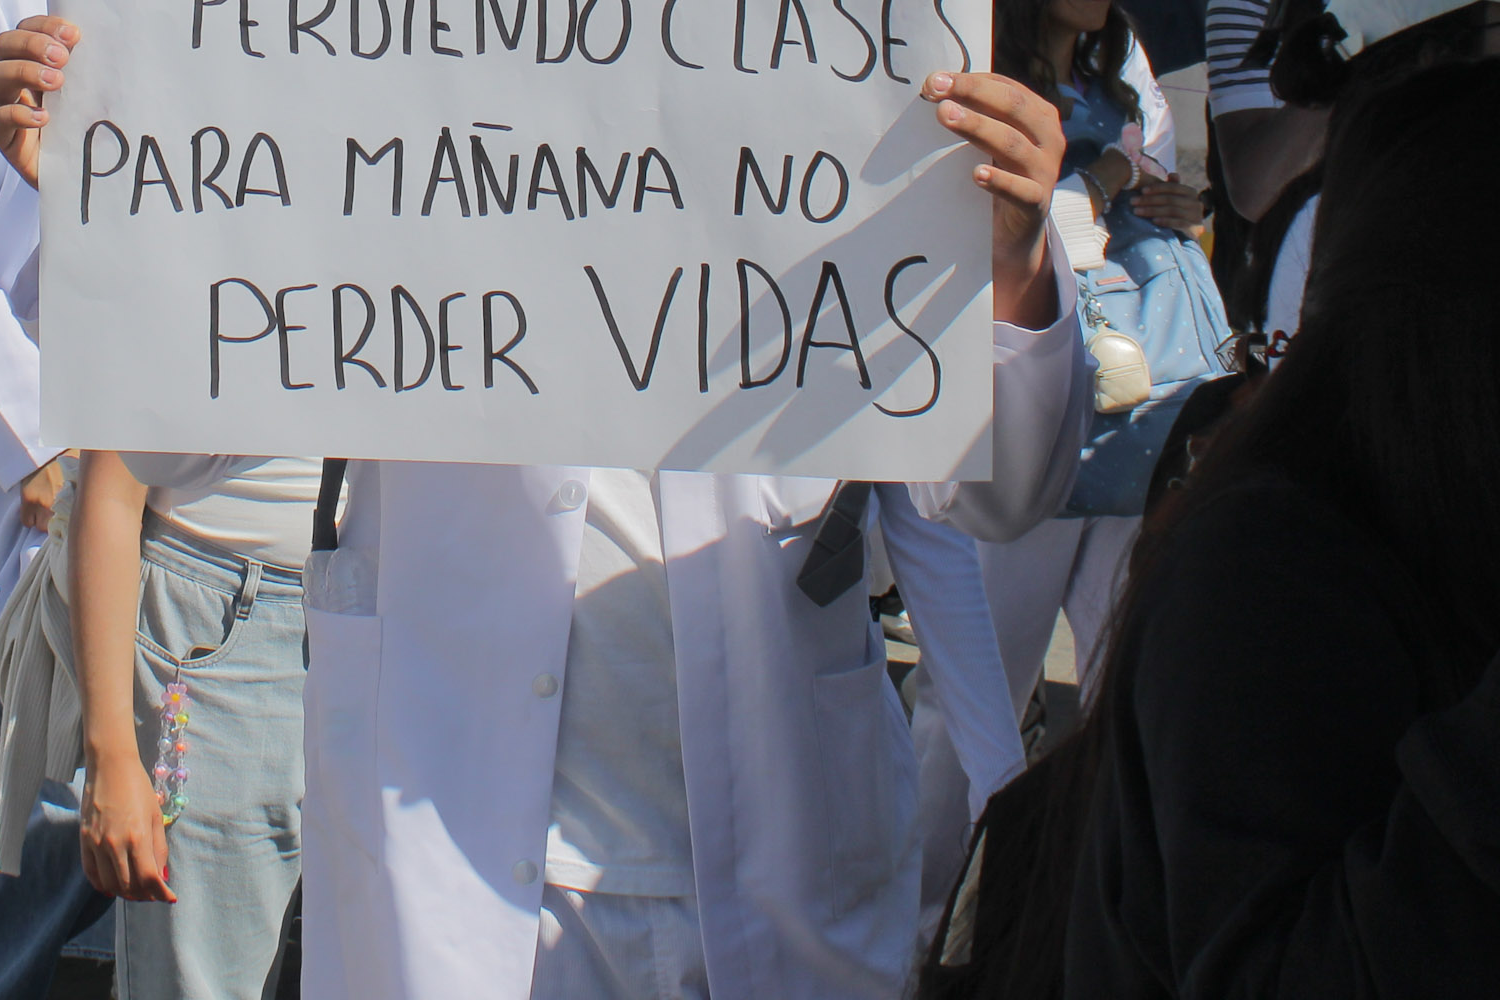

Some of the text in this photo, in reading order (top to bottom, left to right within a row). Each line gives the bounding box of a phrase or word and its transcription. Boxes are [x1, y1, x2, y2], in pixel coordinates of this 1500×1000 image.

[81, 119, 850, 224] PARA MAÑANA NO
[209, 254, 943, 418] PERDER VIDAS
